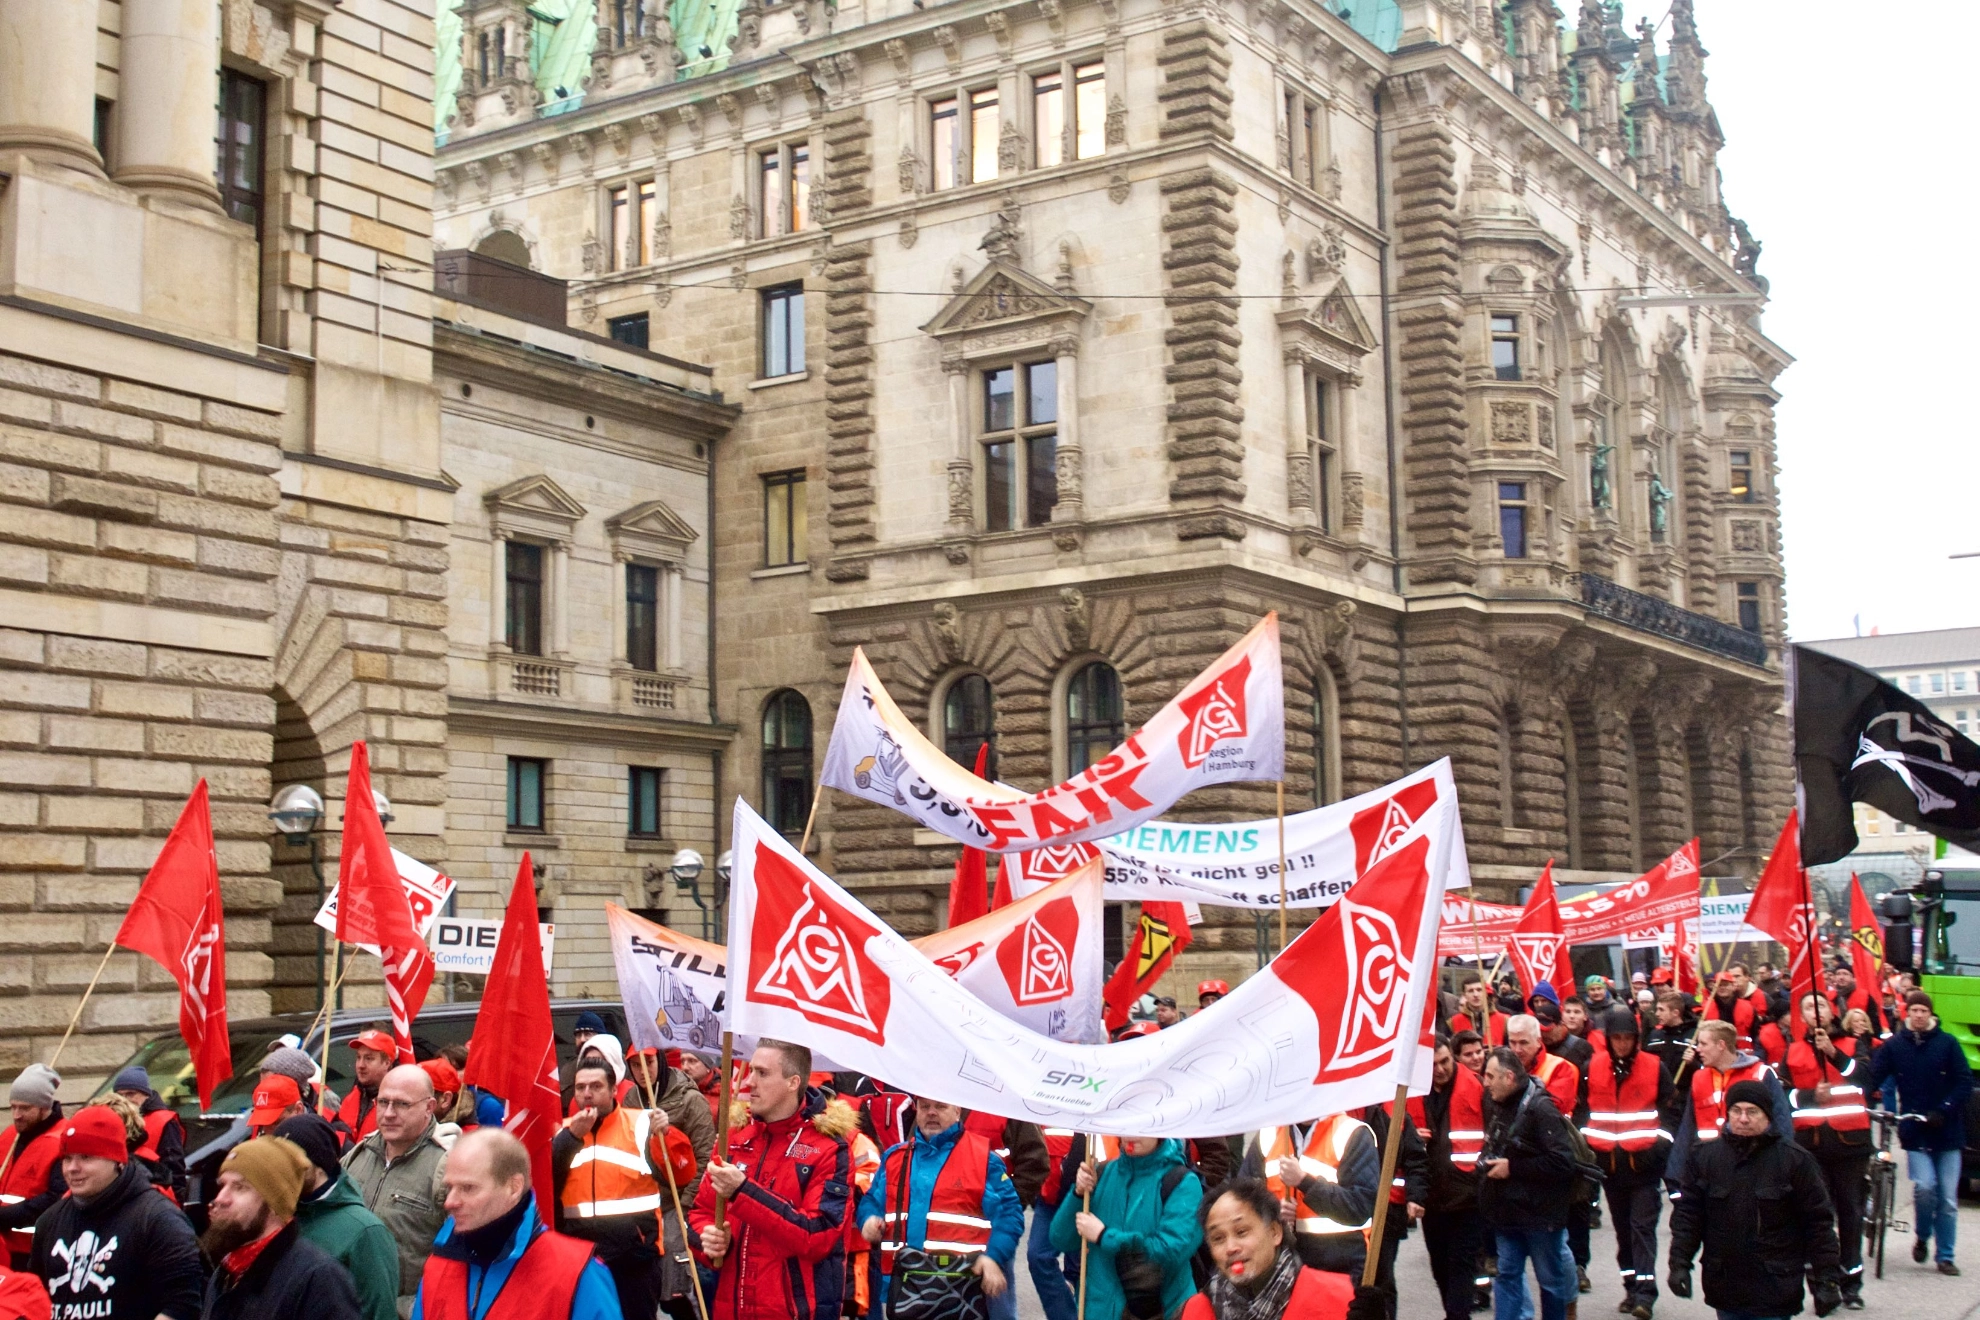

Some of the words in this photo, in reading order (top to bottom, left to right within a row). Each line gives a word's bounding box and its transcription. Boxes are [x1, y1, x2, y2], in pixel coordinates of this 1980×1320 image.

[1208, 760, 1256, 772] Hamburg
[1105, 827, 1259, 854] SIEMENS
[1300, 854, 1316, 868] !!
[1257, 880, 1352, 905] schaffen
[1701, 903, 1749, 916] SIEME
[438, 924, 498, 948] DIE
[436, 951, 484, 967] Comfort
[776, 909, 853, 1005] IGM
[1042, 1070, 1107, 1093] SPX
[64, 1299, 112, 1320] PAULI
